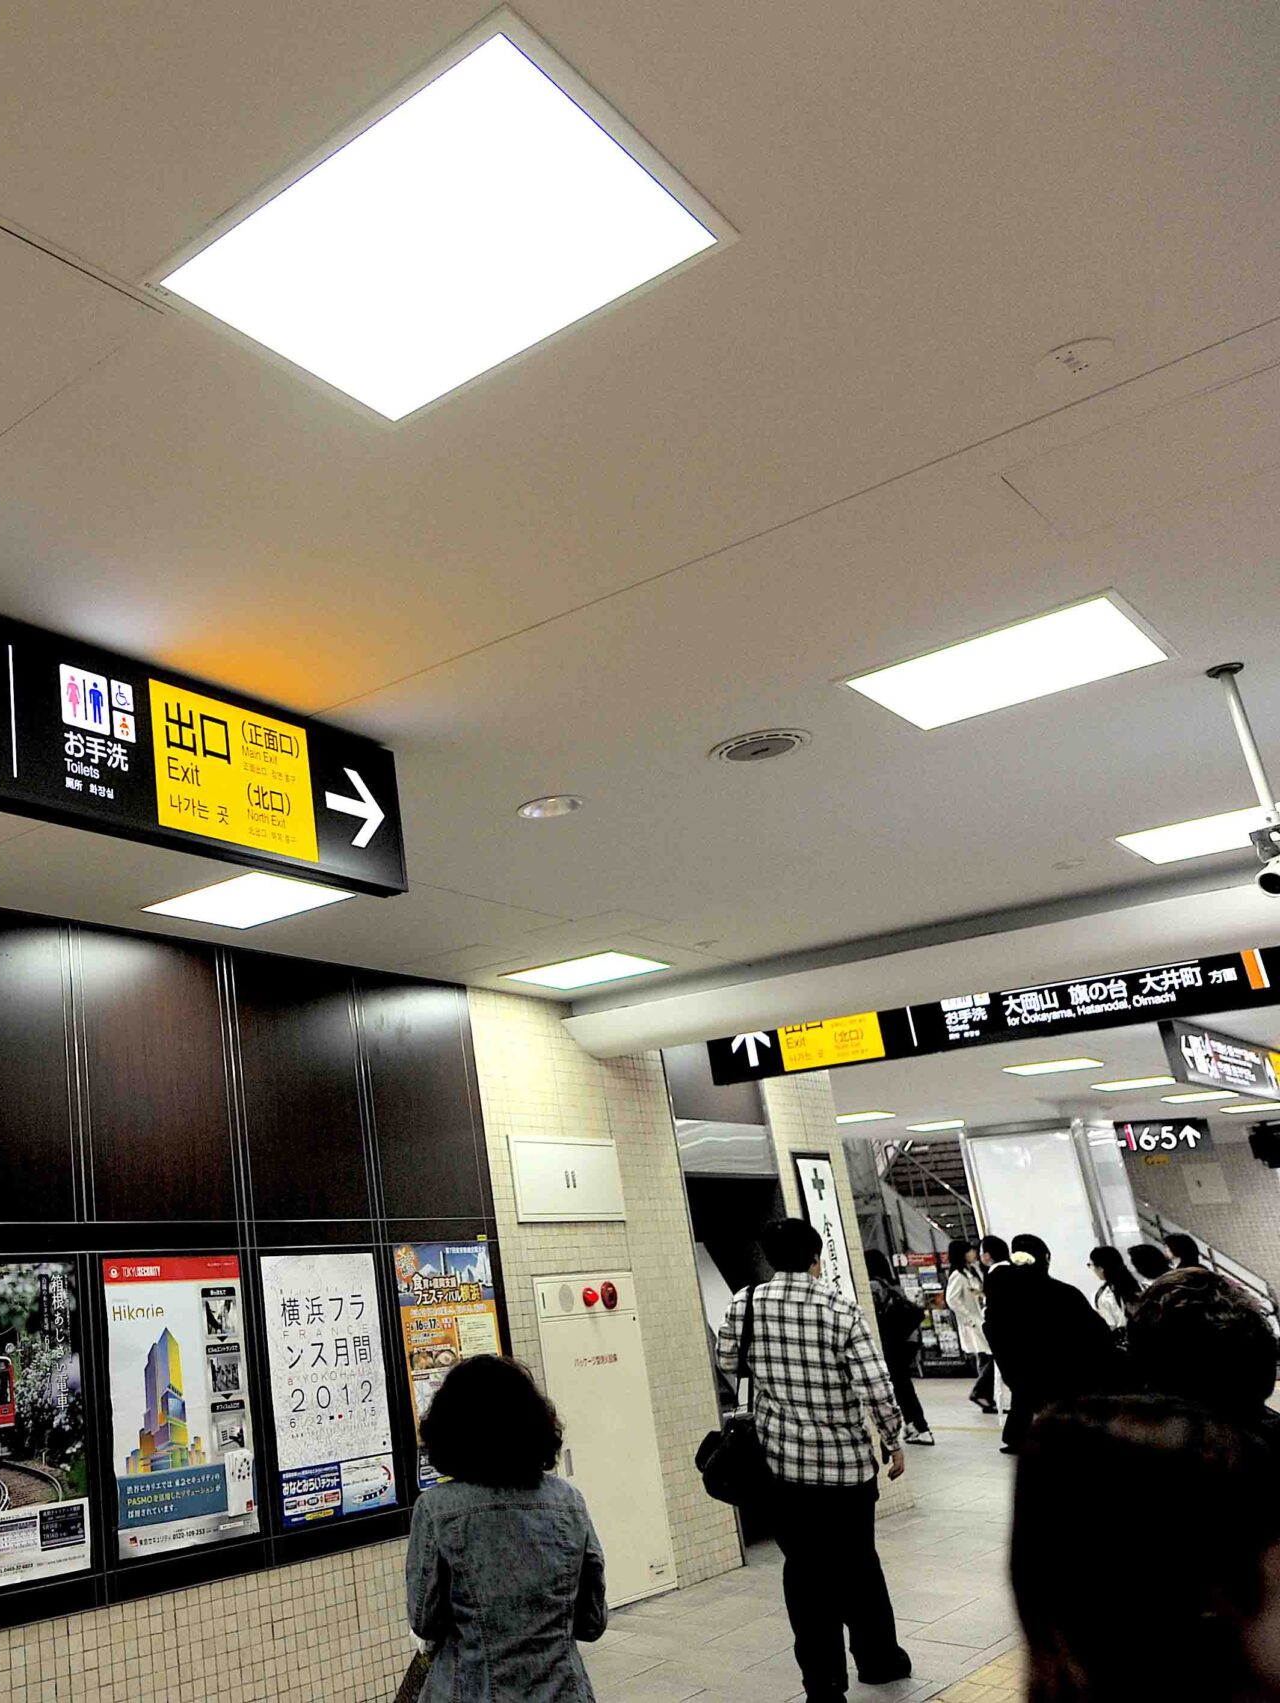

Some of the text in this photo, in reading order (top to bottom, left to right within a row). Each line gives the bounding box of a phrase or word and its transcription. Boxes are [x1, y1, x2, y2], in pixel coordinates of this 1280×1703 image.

[165, 702, 231, 765] 出口
[64, 731, 129, 772] お手洗
[242, 745, 278, 765] Main Exit
[64, 757, 100, 780] Toilets
[167, 756, 201, 787] Exit
[170, 794, 229, 825] 나가는 곳
[247, 809, 286, 829] North Exit
[1002, 967, 1238, 1016] 大岡山 旗の台 大井町 方面
[945, 1007, 988, 1025] お手洗
[1006, 1016, 1021, 1027] for
[1077, 1000, 1132, 1016] Hatanodai,
[786, 1036, 806, 1049] Exit
[112, 1304, 164, 1321] Hikarie
[281, 1294, 364, 1327] 横浜フラ
[287, 1335, 372, 1369] ンス月間
[291, 1380, 372, 1413] 2012
